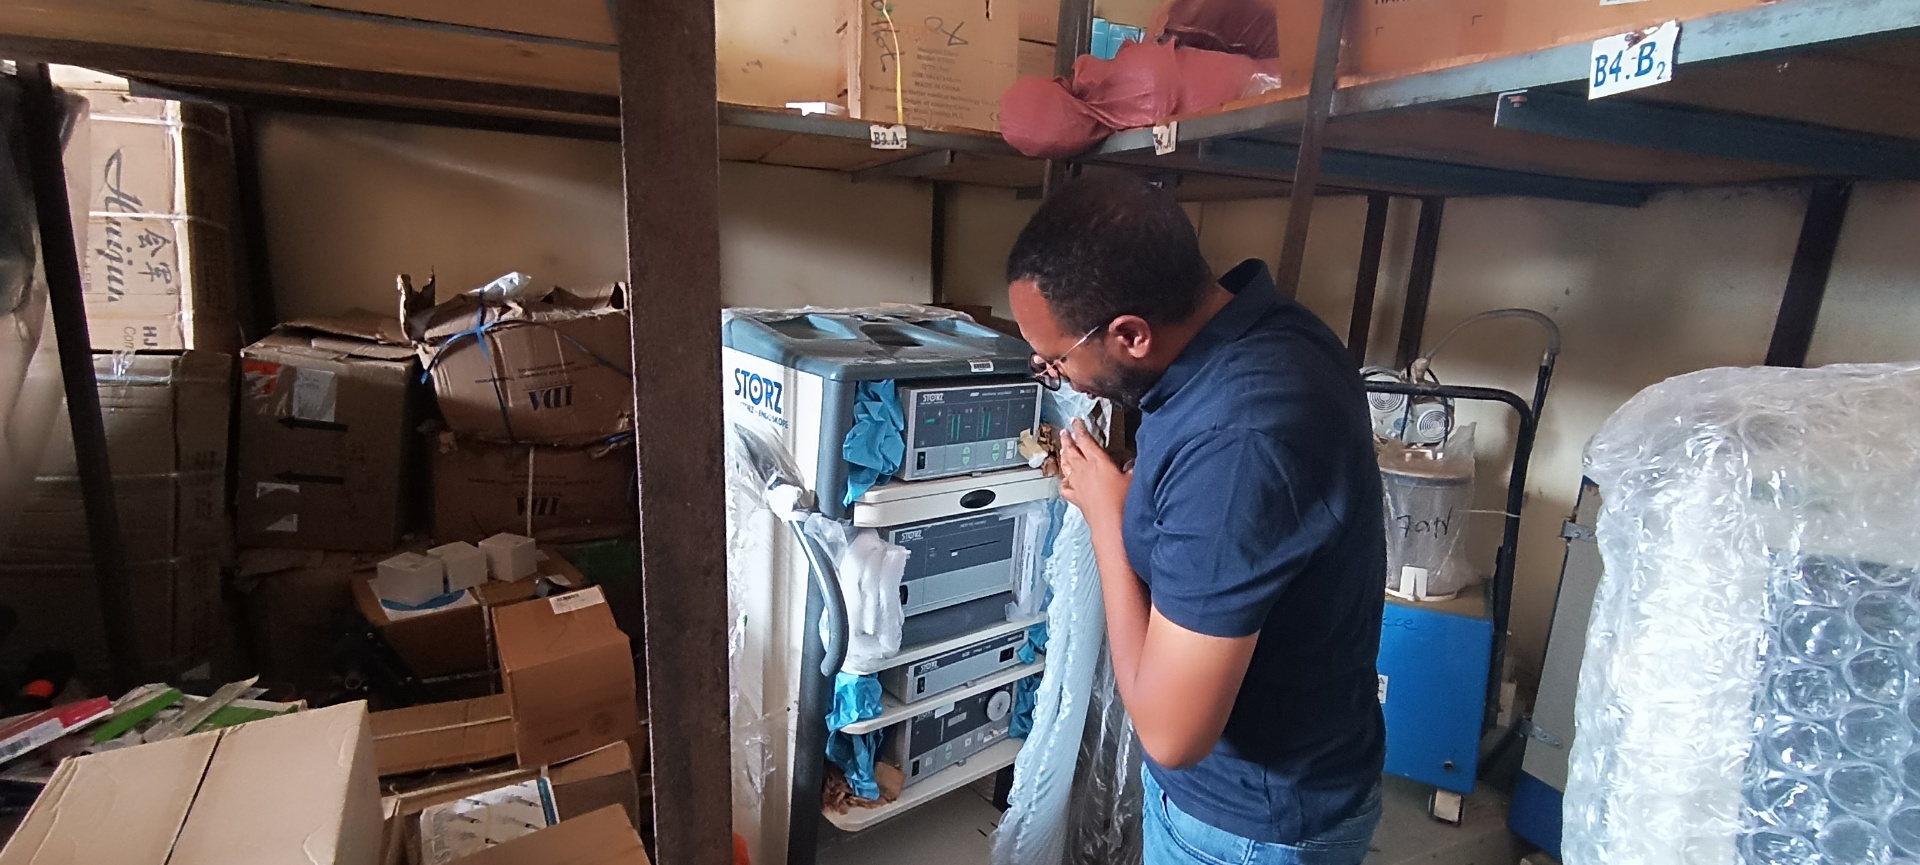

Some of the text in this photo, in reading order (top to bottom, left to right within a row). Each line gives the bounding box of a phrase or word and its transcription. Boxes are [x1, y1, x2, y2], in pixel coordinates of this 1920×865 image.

[914, 81, 932, 89] MADE
[942, 84, 961, 92] CHINA
[734, 367, 783, 415] STORZ
[528, 385, 573, 410] IDA
[922, 392, 945, 403] STORZ
[901, 529, 923, 541] STORZ
